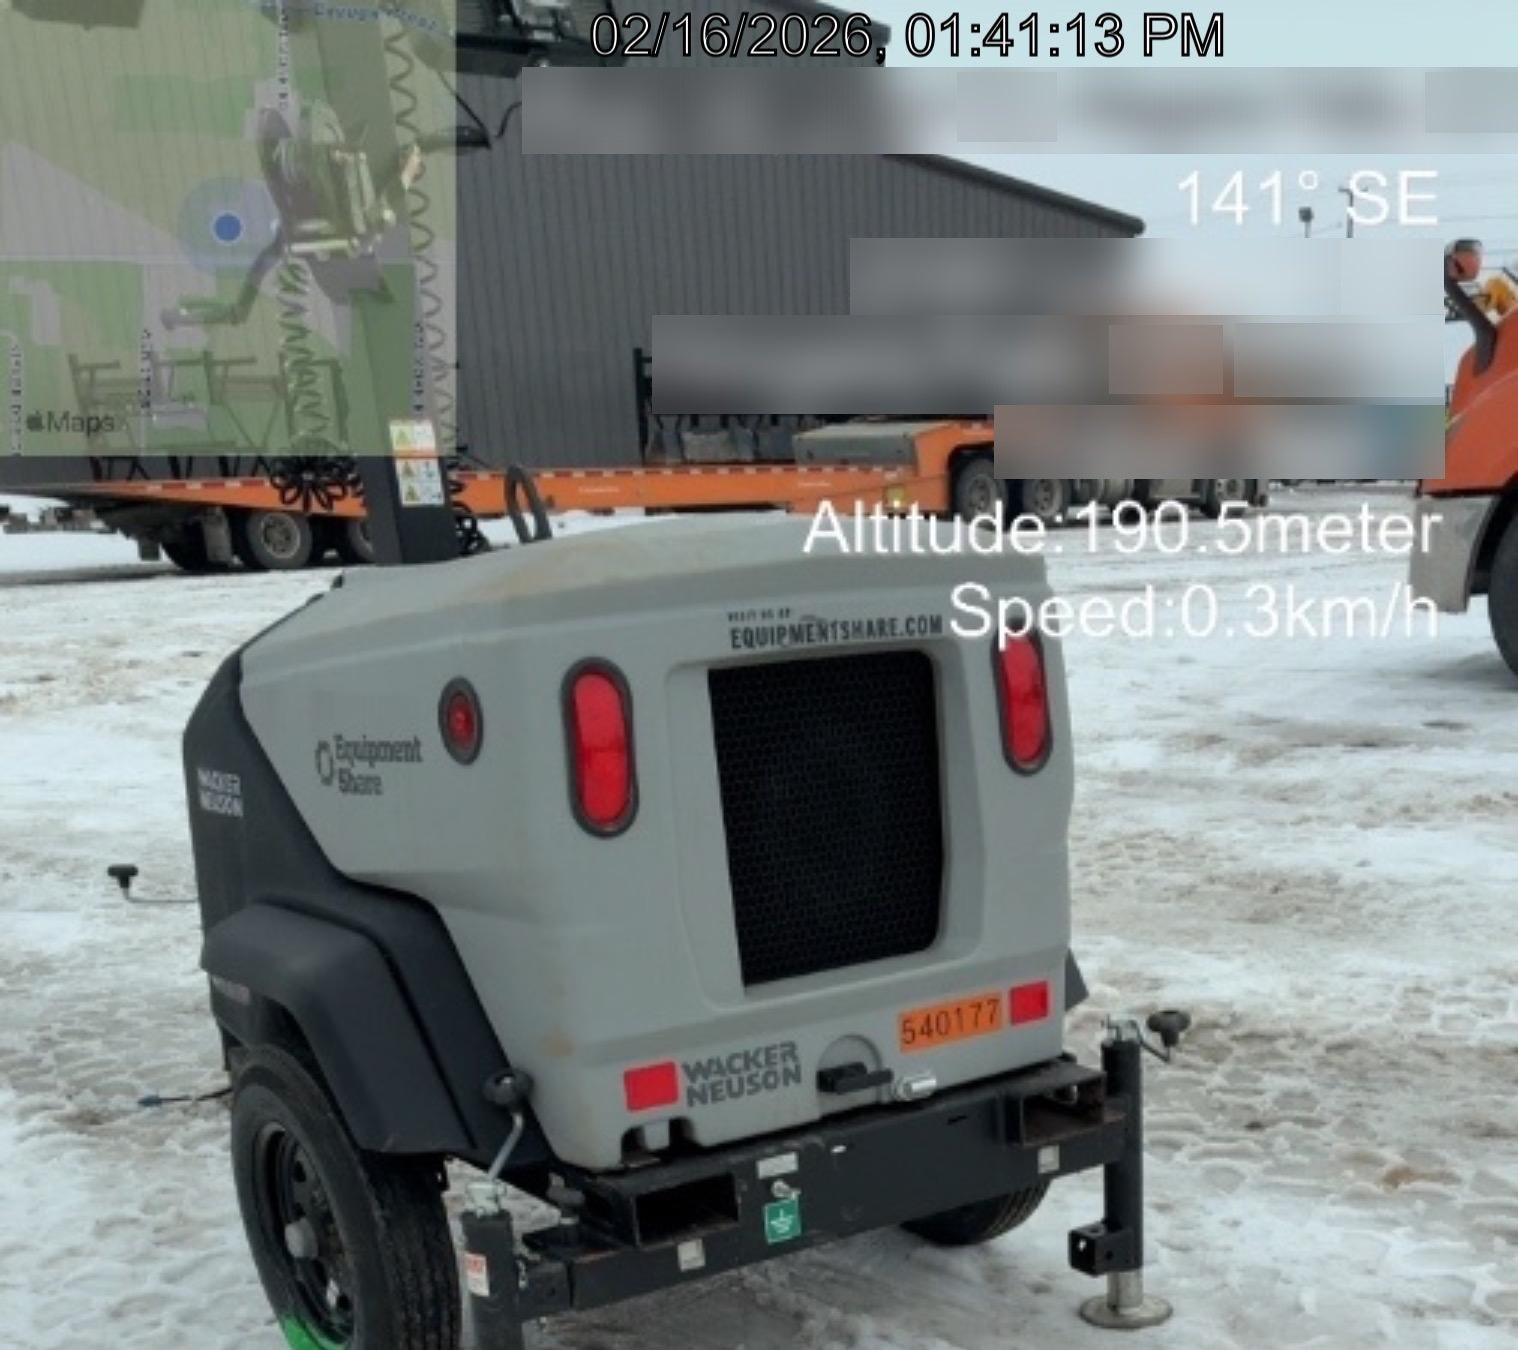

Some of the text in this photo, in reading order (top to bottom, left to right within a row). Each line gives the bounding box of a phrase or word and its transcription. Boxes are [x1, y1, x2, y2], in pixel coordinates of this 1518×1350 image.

[730, 614, 943, 649] EQUIPMENTSHARE.COM
[333, 734, 423, 768] Equipment
[338, 767, 383, 796] Share
[901, 998, 1000, 1044] 540177
[682, 1041, 798, 1080] WACKER
[686, 1065, 801, 1107] NEUSON
